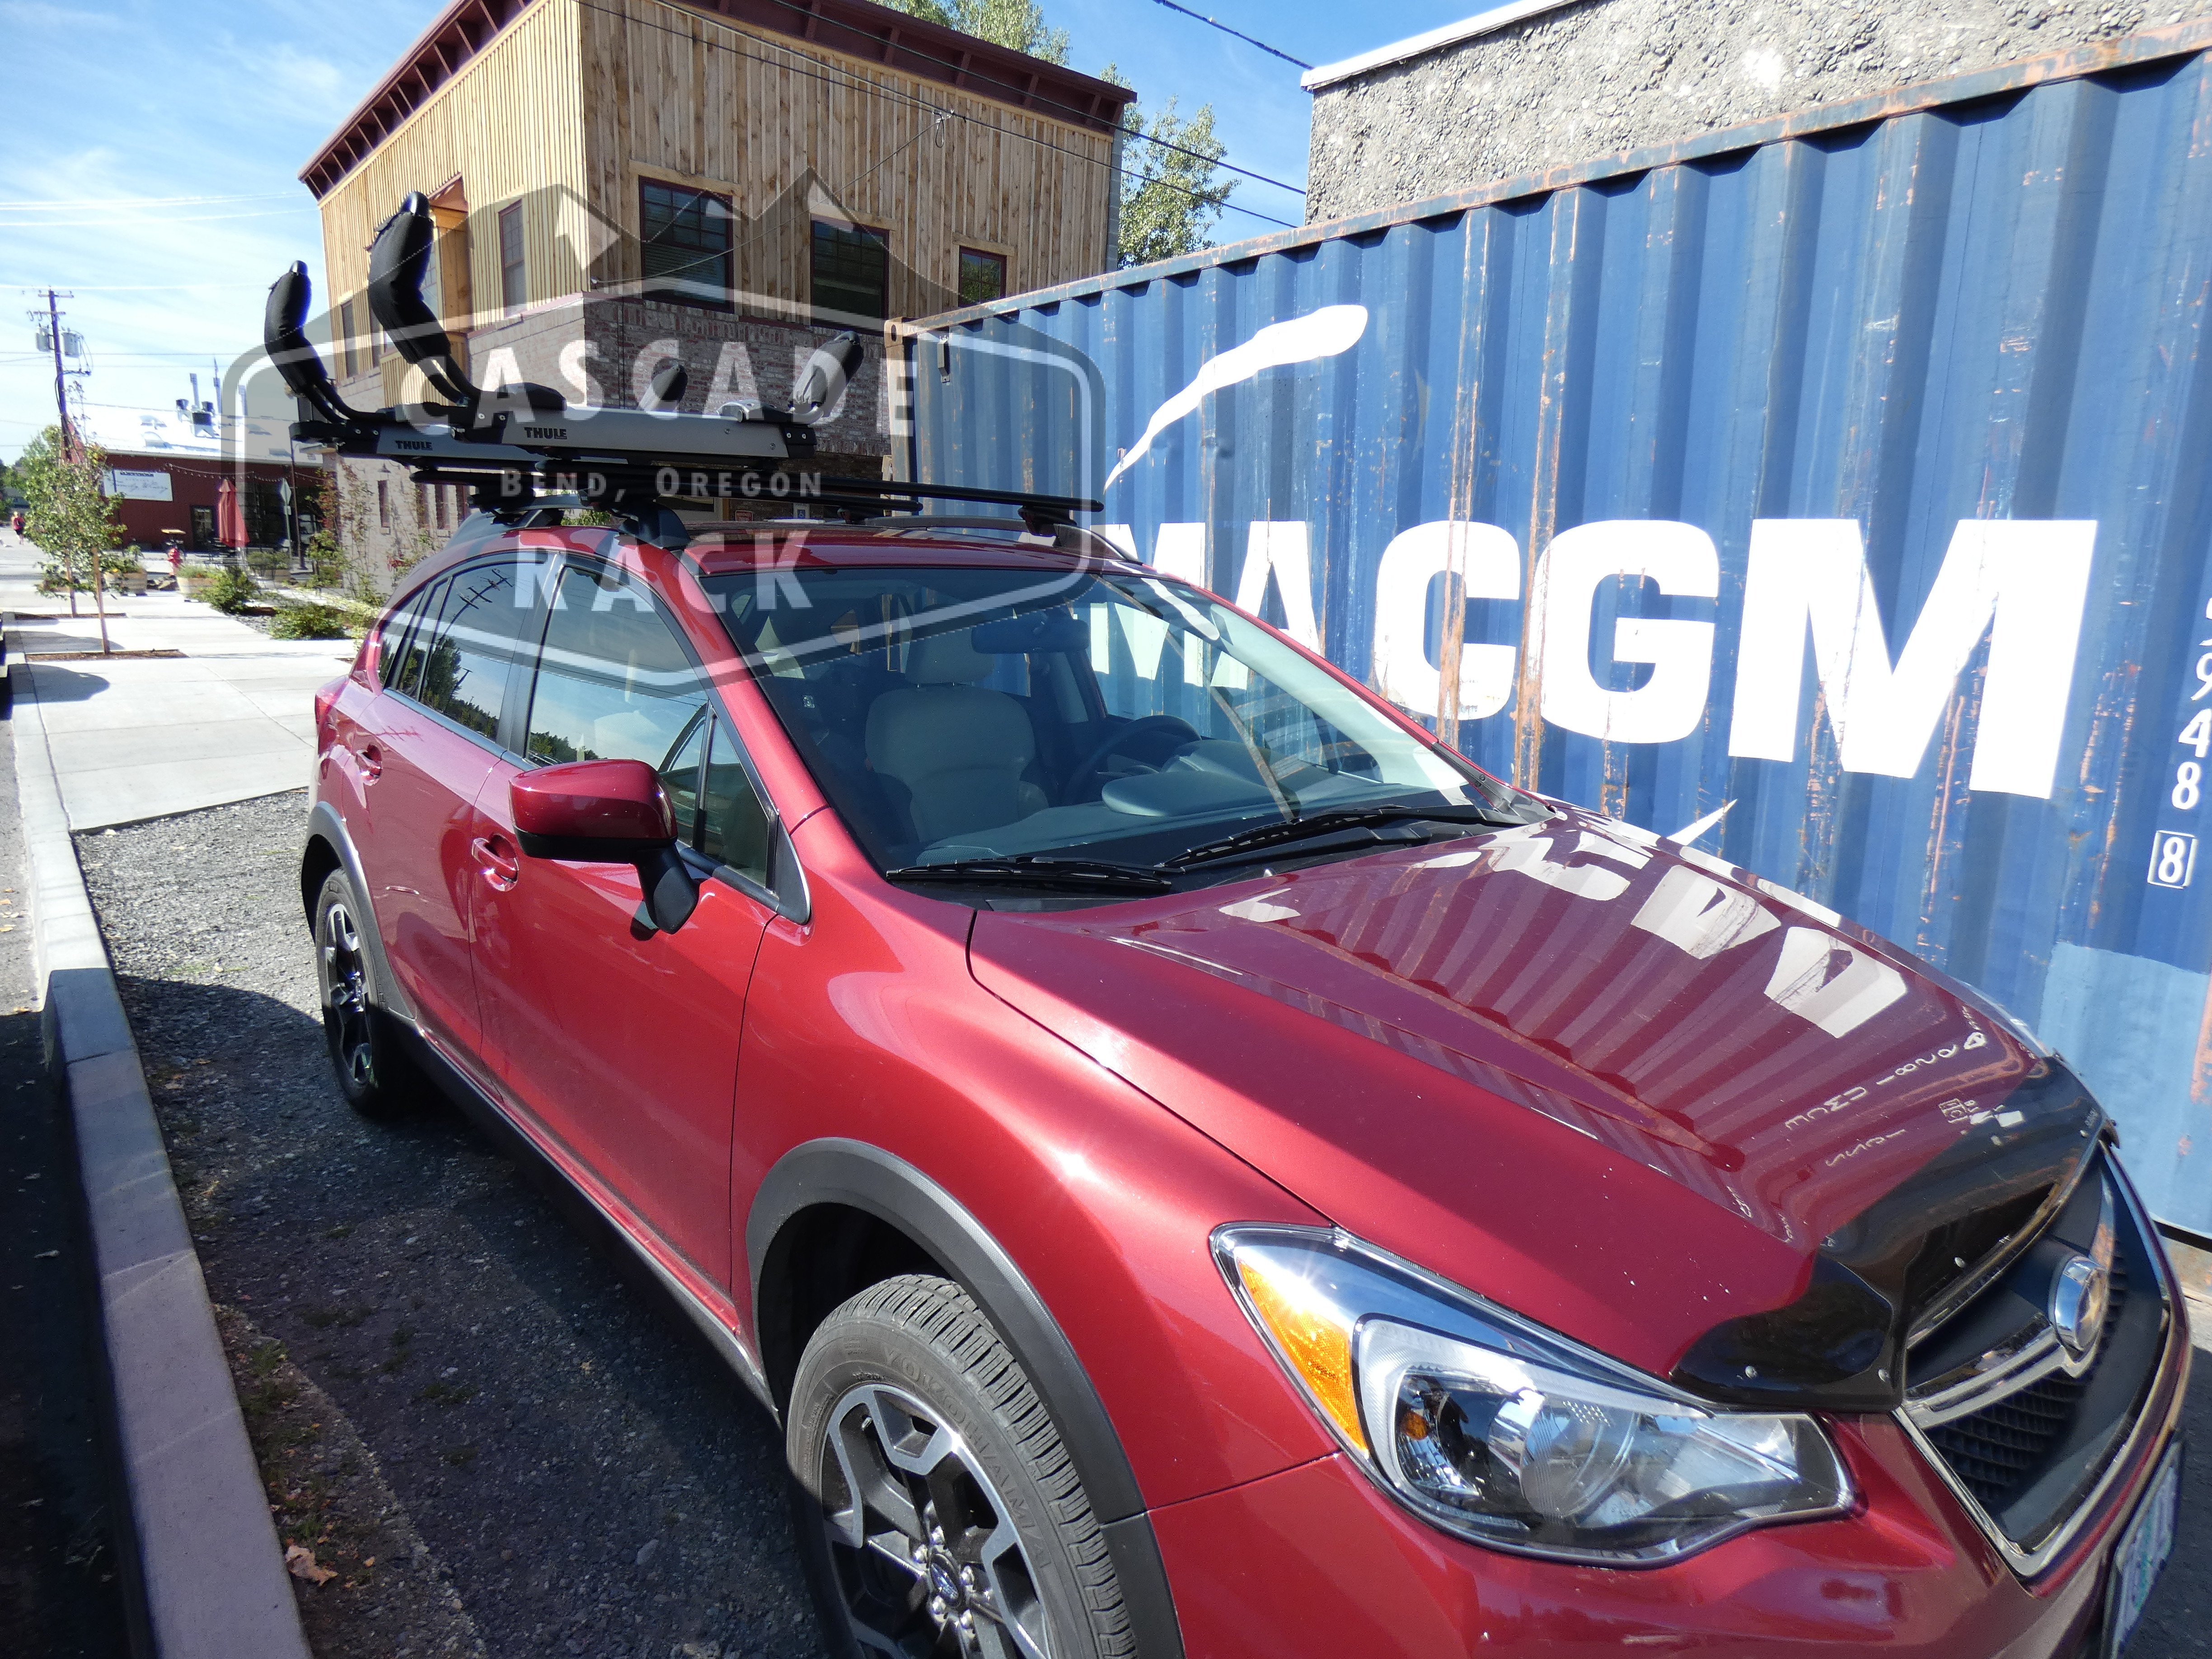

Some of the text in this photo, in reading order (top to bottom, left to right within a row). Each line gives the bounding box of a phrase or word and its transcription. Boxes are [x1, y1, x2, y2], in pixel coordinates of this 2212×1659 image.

[524, 426, 567, 440] THULE
[395, 440, 433, 451] THULE
[2158, 836, 2187, 883] 8
